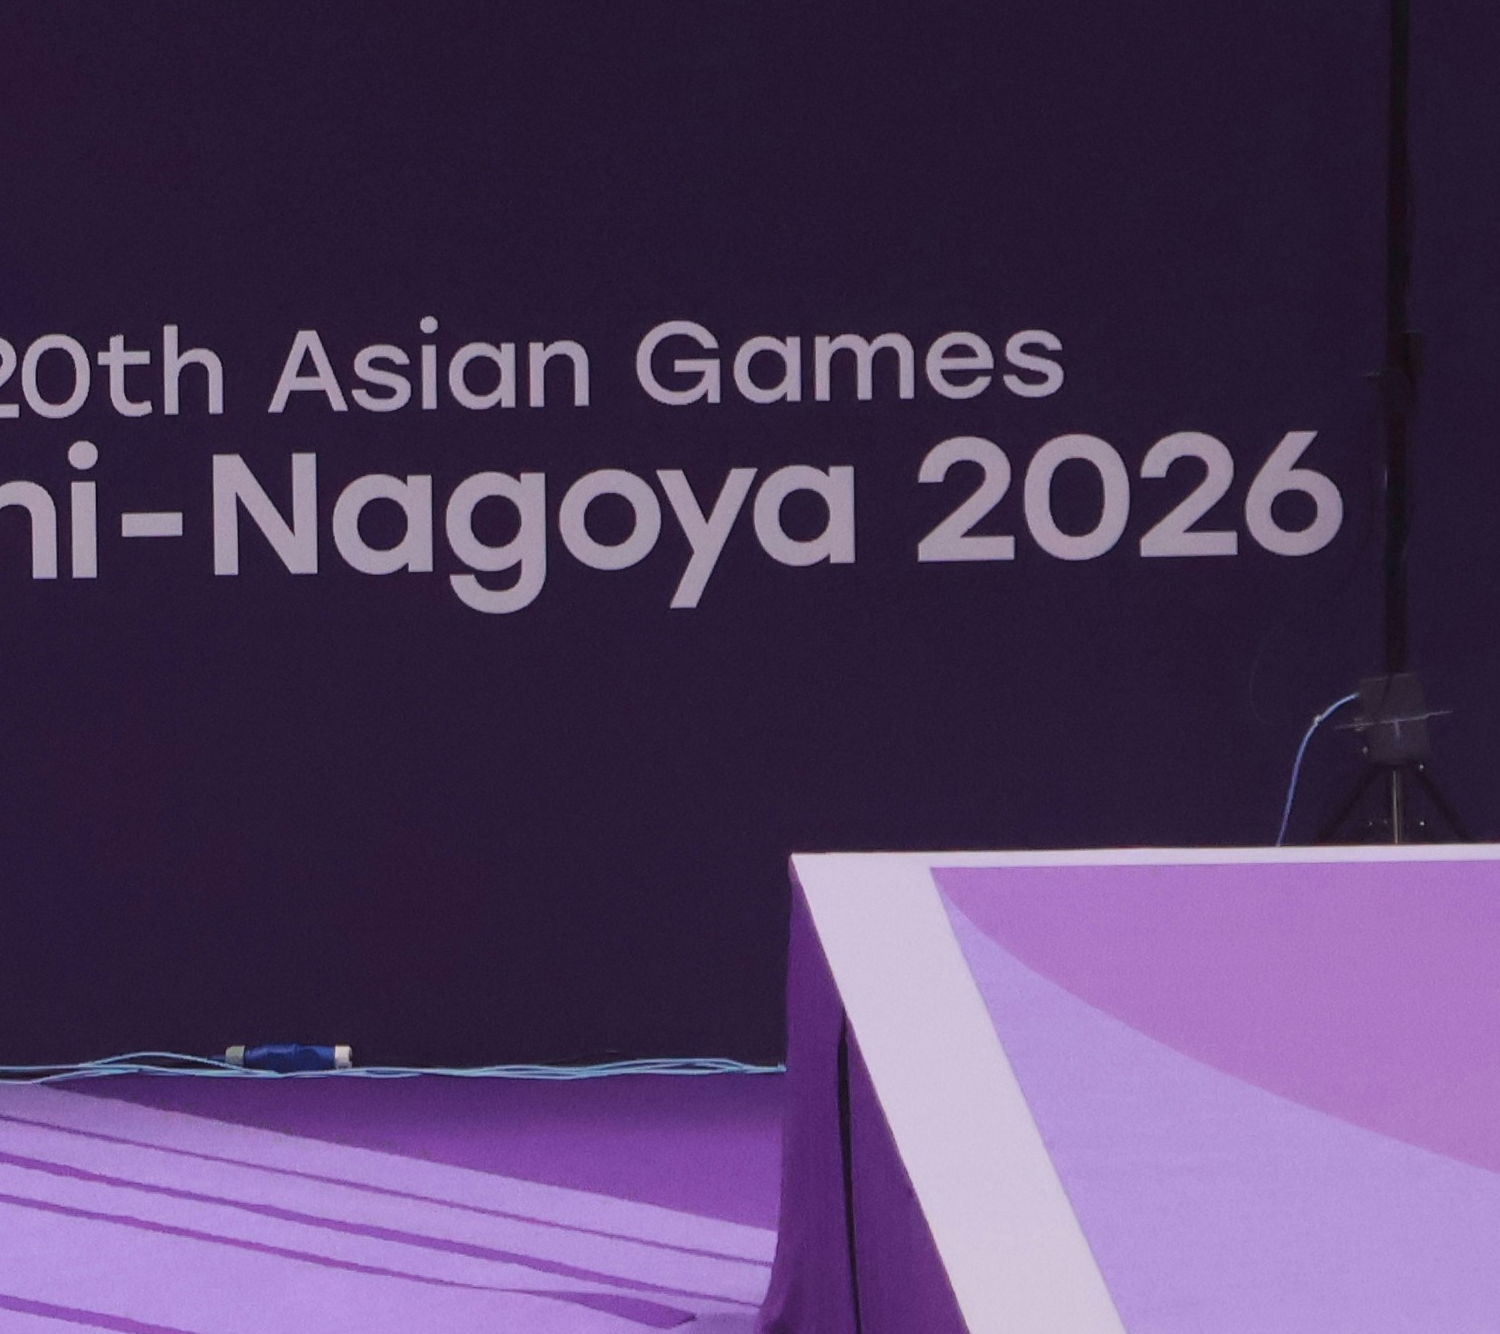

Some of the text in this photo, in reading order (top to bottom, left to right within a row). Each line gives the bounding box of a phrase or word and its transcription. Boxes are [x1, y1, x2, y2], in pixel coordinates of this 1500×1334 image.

[268, 316, 590, 413] Asian
[636, 319, 1064, 406] Games
[917, 430, 1343, 562] 2026
